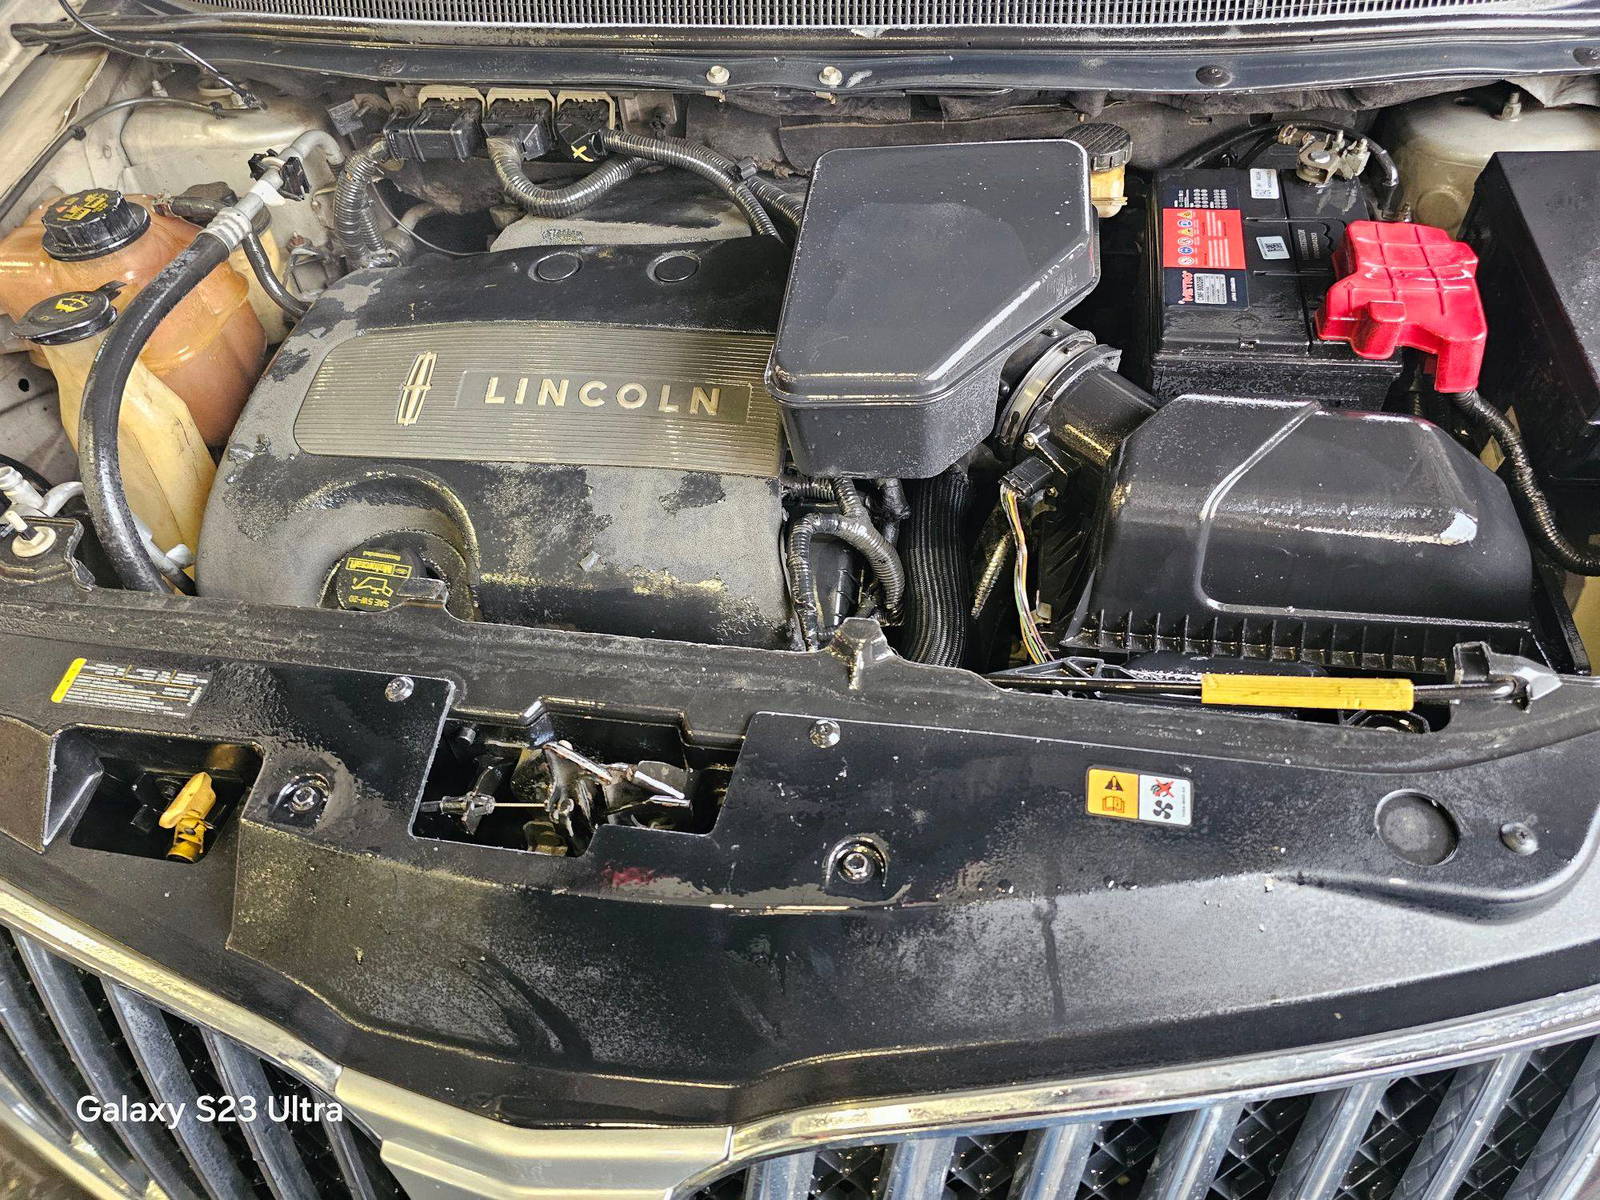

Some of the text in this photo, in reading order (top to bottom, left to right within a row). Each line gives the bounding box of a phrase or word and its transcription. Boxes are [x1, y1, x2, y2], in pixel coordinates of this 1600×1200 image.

[1182, 271, 1193, 302] METRO
[484, 377, 721, 417] LINCOLN
[373, 598, 390, 608] SAE
